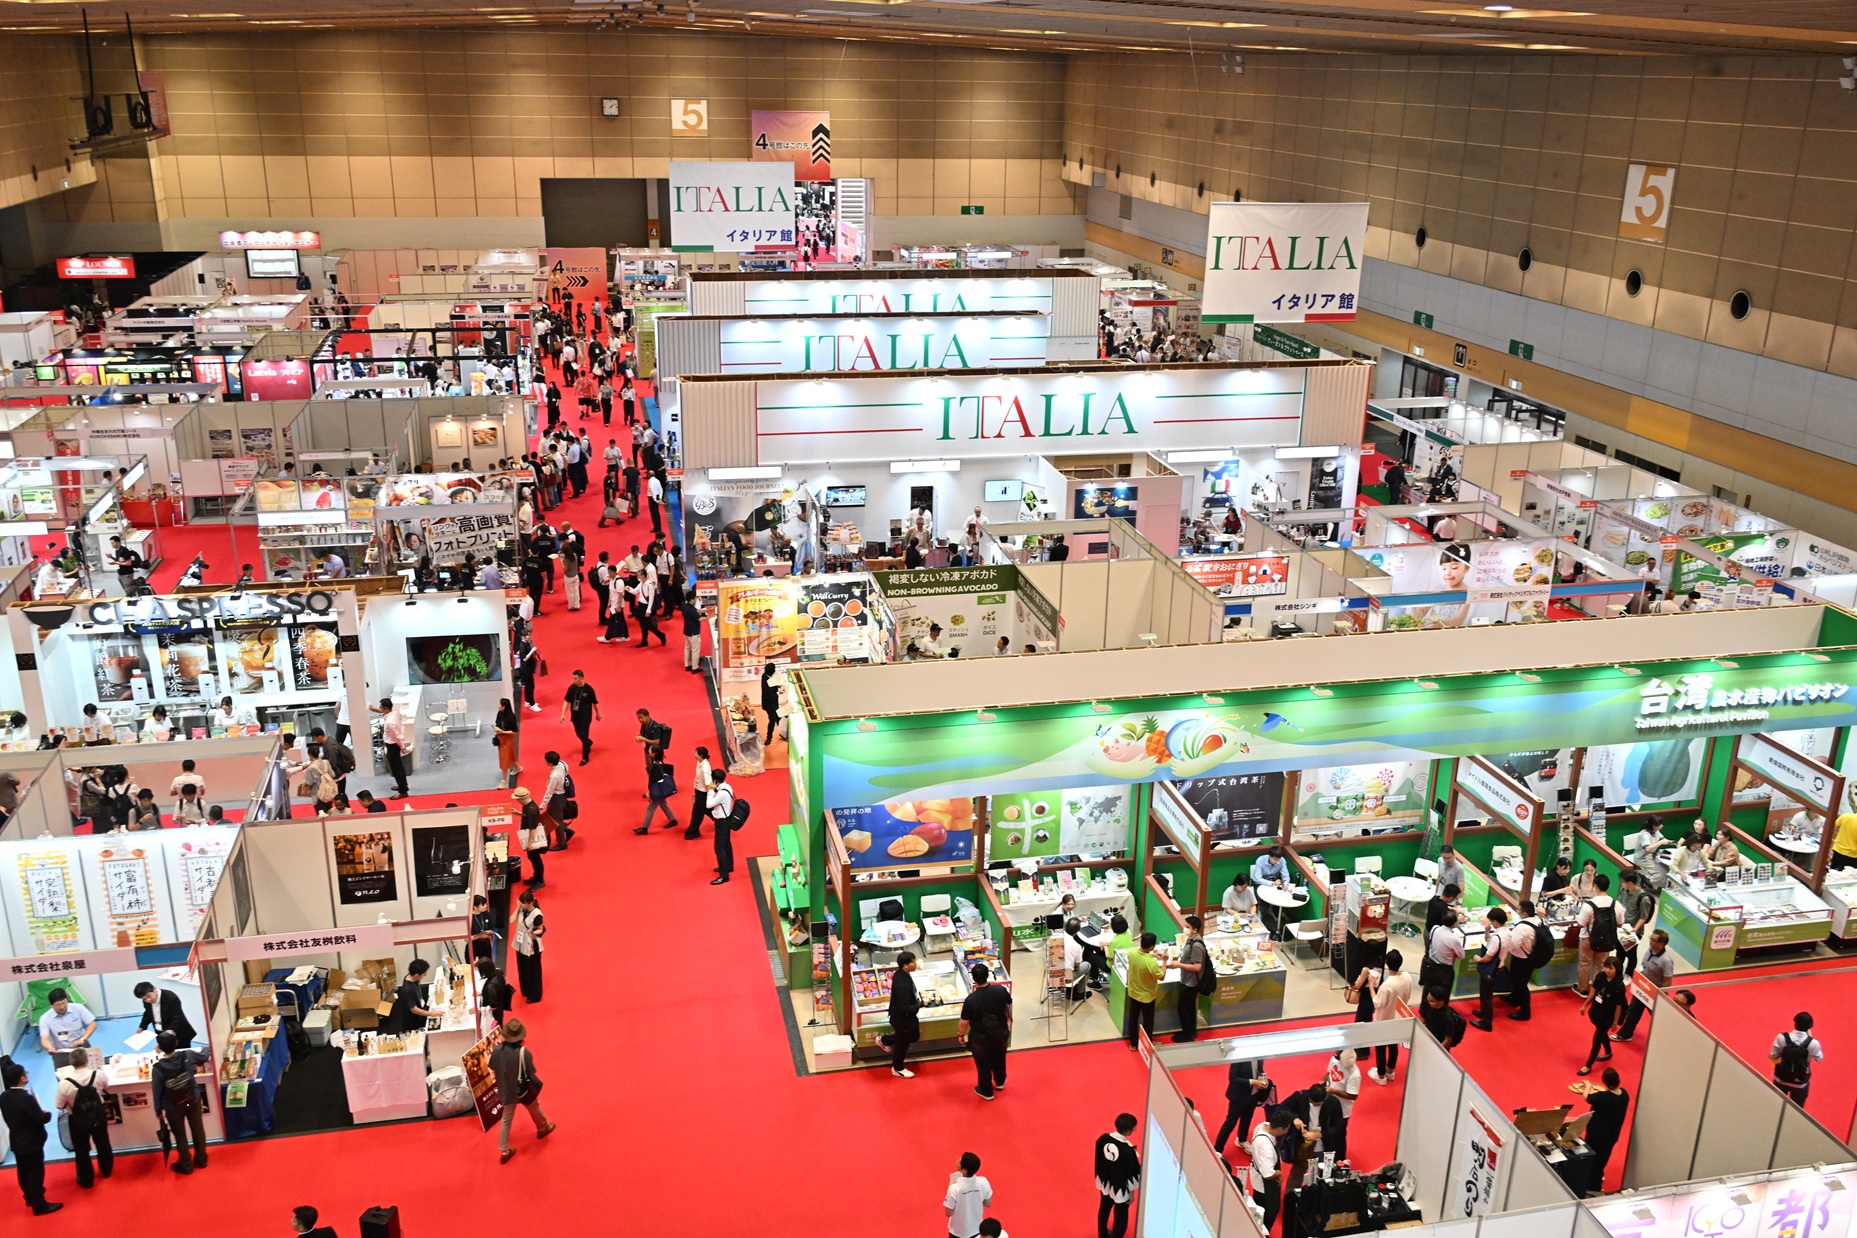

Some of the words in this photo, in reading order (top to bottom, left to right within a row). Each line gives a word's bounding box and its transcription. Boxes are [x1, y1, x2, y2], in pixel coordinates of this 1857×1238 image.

[681, 99, 704, 130] 5
[755, 132, 810, 151] 4号館はこの先
[673, 186, 792, 213] ITALIA
[1634, 165, 1668, 226] 5
[650, 228, 657, 237] 4
[726, 229, 793, 243] イタリア館
[1209, 235, 1358, 271] ITALIA
[553, 259, 600, 274] 4号館はこの先
[830, 293, 968, 313] ITALIA
[1271, 292, 1355, 311] イタリア館
[800, 333, 971, 371] ITALIA
[248, 369, 277, 377] Latvia
[936, 391, 1139, 440] ITALIA
[456, 514, 512, 534] 高画質
[433, 529, 514, 553] フォトプリント
[888, 569, 997, 585] 褐変しない冷凍アボカド
[957, 583, 998, 593] AVOCADO
[89, 595, 170, 626] CHA
[1274, 602, 1318, 611] 株式会社シンギ
[291, 626, 312, 687] 四季春茶
[1635, 716, 1670, 729] Taiwan
[1671, 711, 1729, 728] Agricultural
[1728, 710, 1770, 722] Pavilion
[1176, 776, 1259, 790] ドリップ式台湾茶
[835, 807, 872, 816] の発祥の地
[45, 878, 62, 913] 完熟梨
[113, 872, 127, 912] サイダー
[125, 869, 142, 911] 富有柿
[195, 868, 205, 903] サイダー
[35, 879, 47, 915] サイダー
[263, 934, 357, 952] 株式会社友桝飲料
[11, 959, 87, 975] 株式会社泉屋
[1464, 1140, 1486, 1218] 明石のり
[1767, 1189, 1834, 1238] 都
